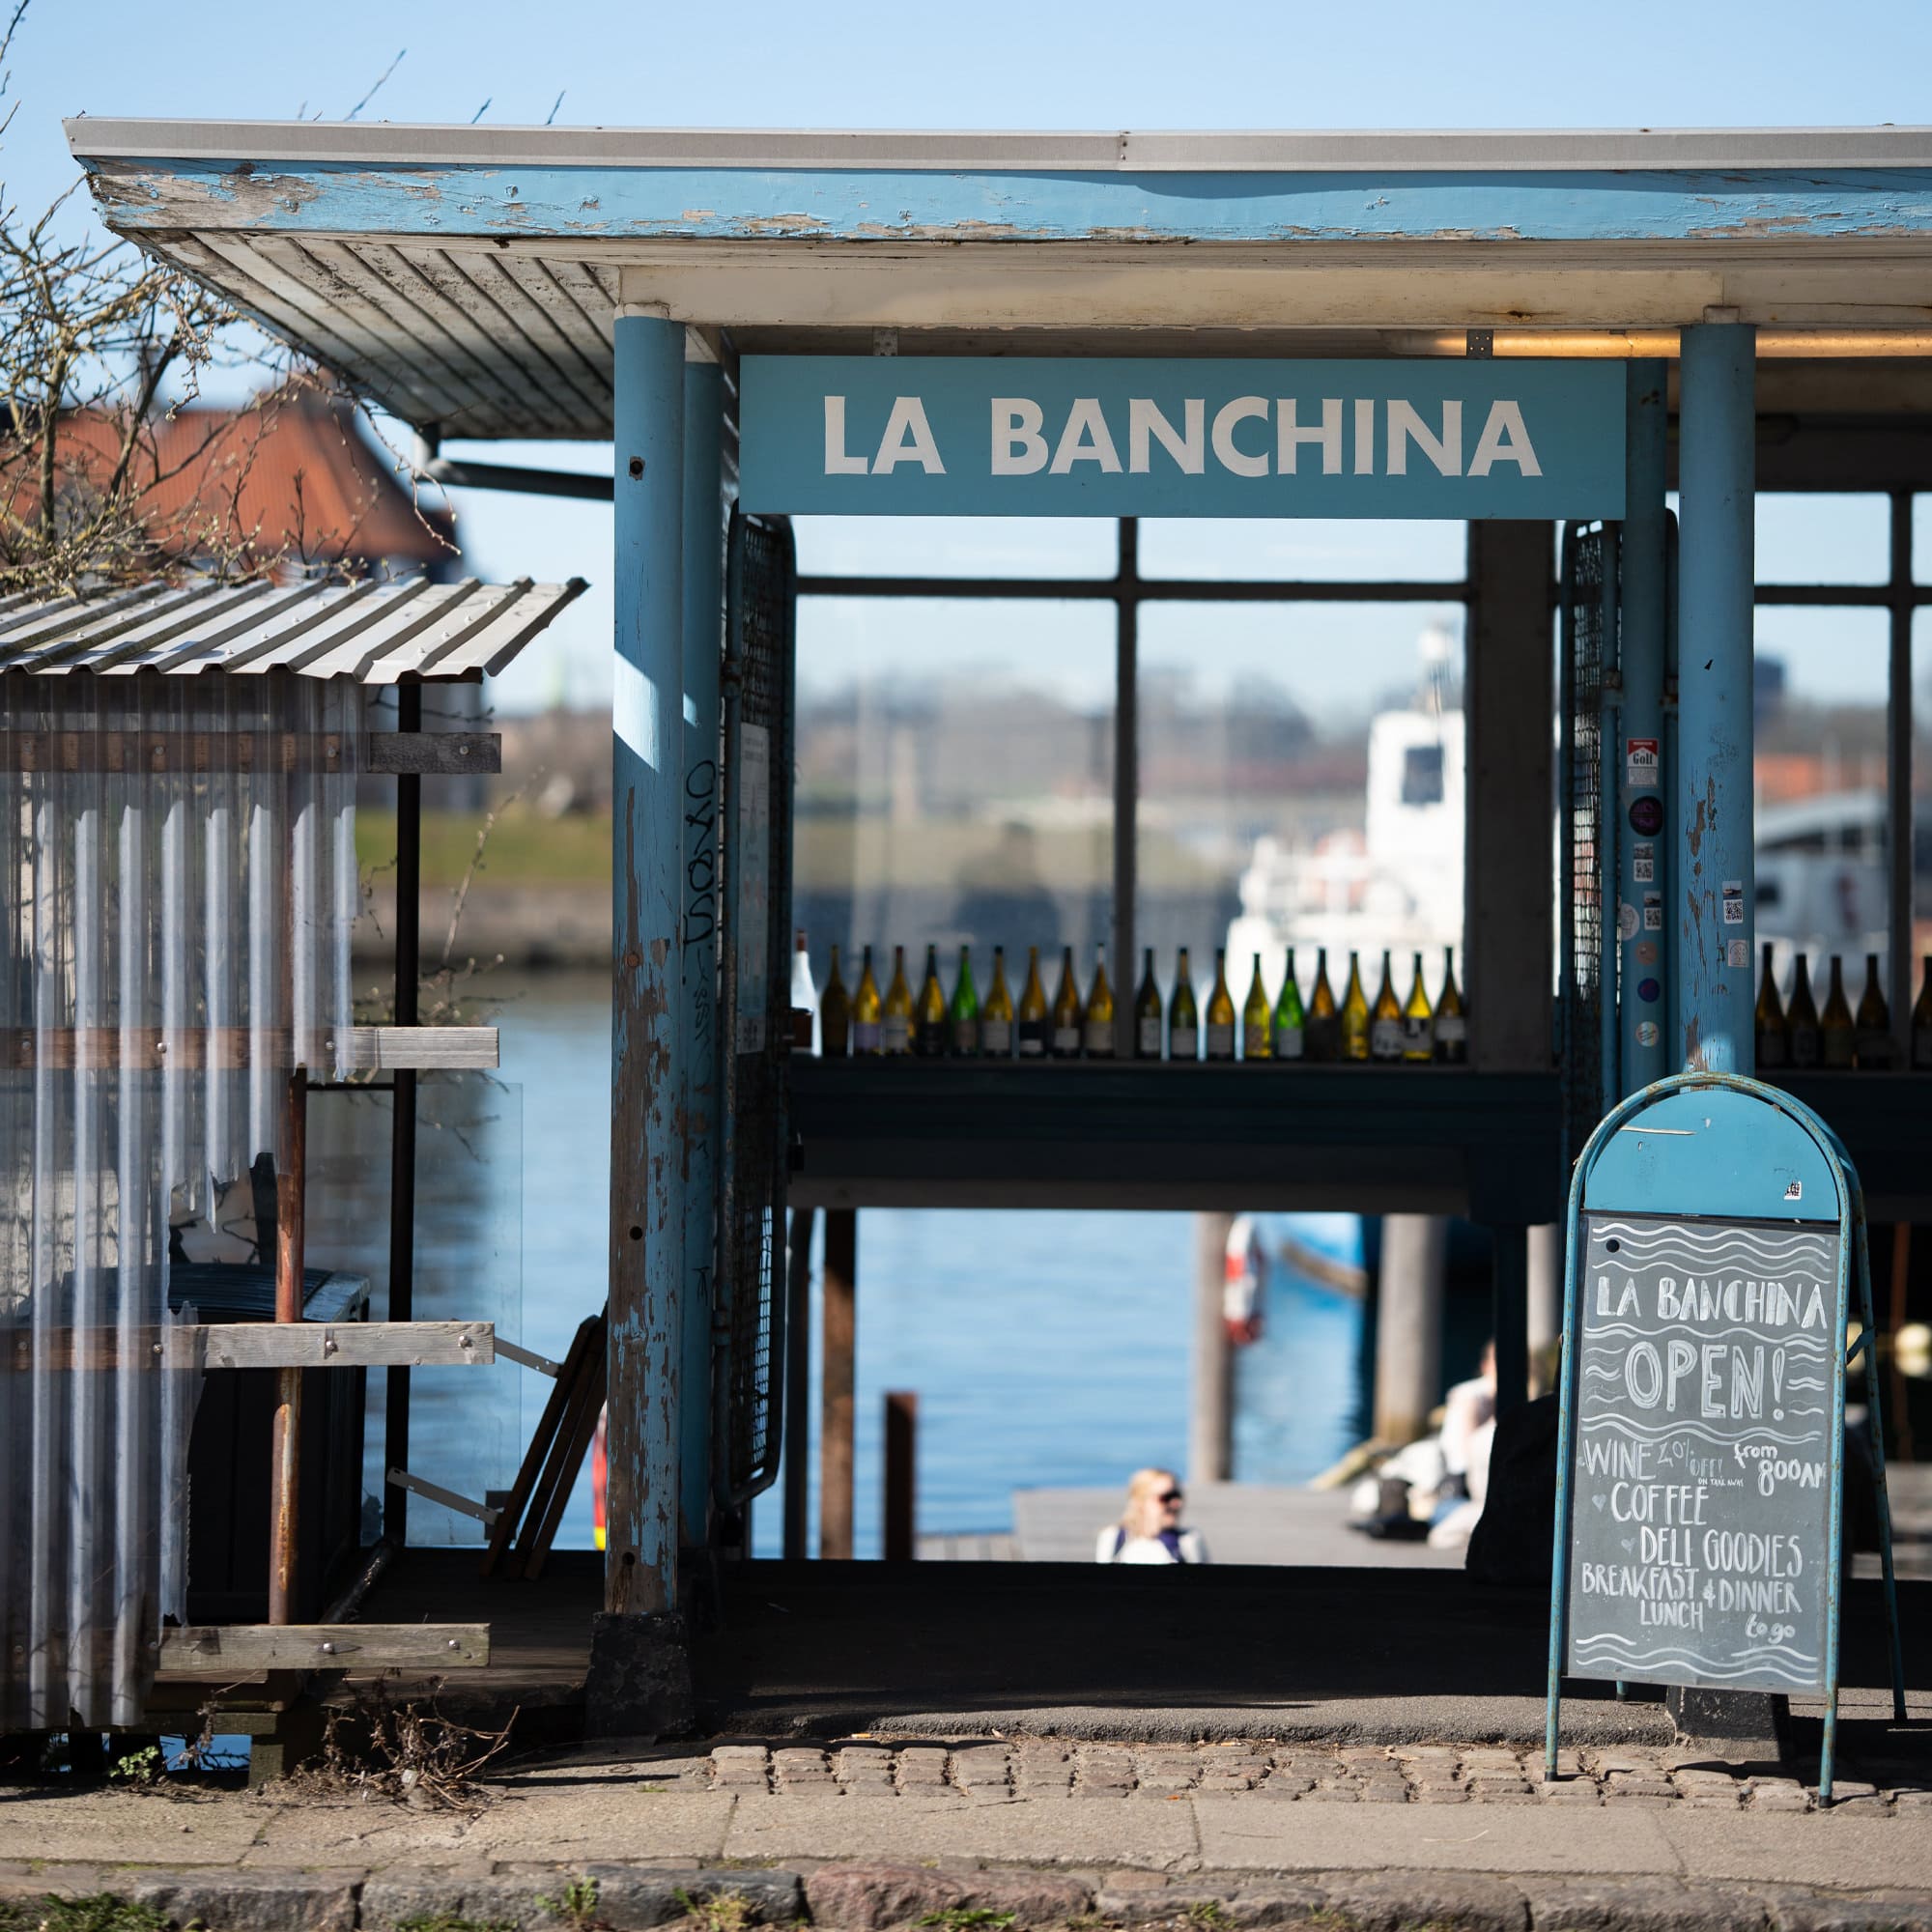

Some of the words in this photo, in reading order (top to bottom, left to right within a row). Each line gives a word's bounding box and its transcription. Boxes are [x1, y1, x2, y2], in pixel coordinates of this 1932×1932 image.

[824, 395, 947, 475] LA
[990, 395, 1544, 479] BANCHINA
[1596, 1276, 1641, 1318] LA
[1657, 1277, 1828, 1329] BANCHINA
[1625, 1340, 1786, 1421] OPEN!
[1583, 1437, 1657, 1481] WINE
[1734, 1442, 1778, 1469] from
[1610, 1481, 1710, 1526] COFFEE
[1640, 1525, 1691, 1567] DELI
[1702, 1528, 1803, 1577] GOODIES
[1581, 1562, 1699, 1602] BREAKFAST
[1719, 1577, 1803, 1614] DINNER
[1640, 1599, 1704, 1633] LUNCH
